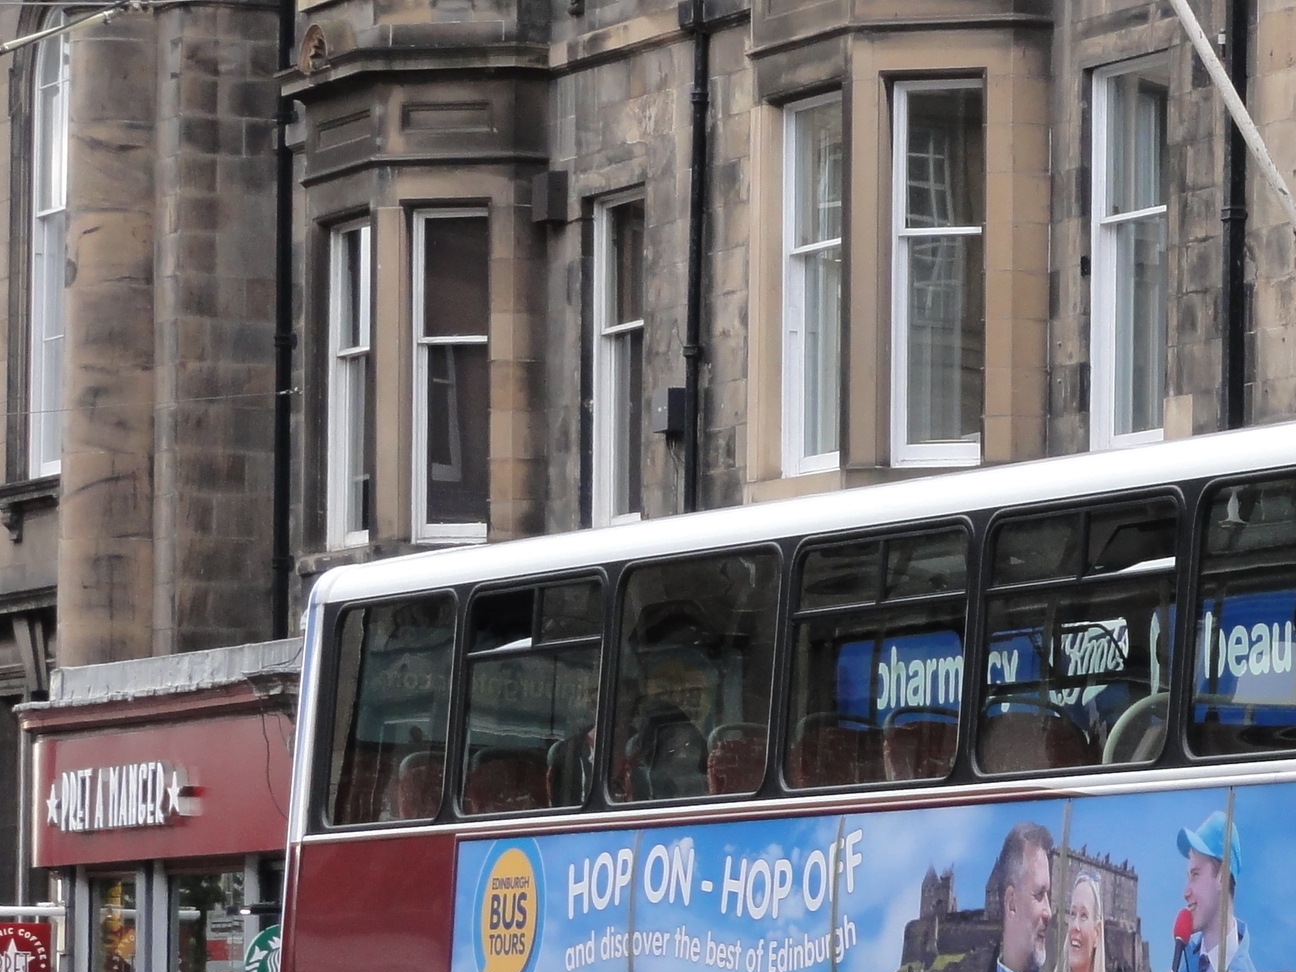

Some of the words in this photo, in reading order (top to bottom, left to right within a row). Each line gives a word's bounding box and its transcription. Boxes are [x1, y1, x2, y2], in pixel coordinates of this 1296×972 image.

[61, 768, 93, 832] PRET
[94, 768, 104, 829] A
[108, 761, 165, 828] MANGER
[491, 876, 530, 890] EDINBURGH
[568, 848, 635, 920] HOP
[643, 843, 695, 907] ON
[720, 855, 793, 920] HOP
[802, 829, 864, 912] OFF
[489, 892, 528, 930] BUS
[489, 933, 526, 955] TOURS
[565, 930, 595, 972] and
[600, 927, 670, 958] discover
[674, 926, 701, 964] the
[705, 931, 741, 970] best
[745, 937, 765, 972] of
[768, 915, 857, 972] Edinburgh
